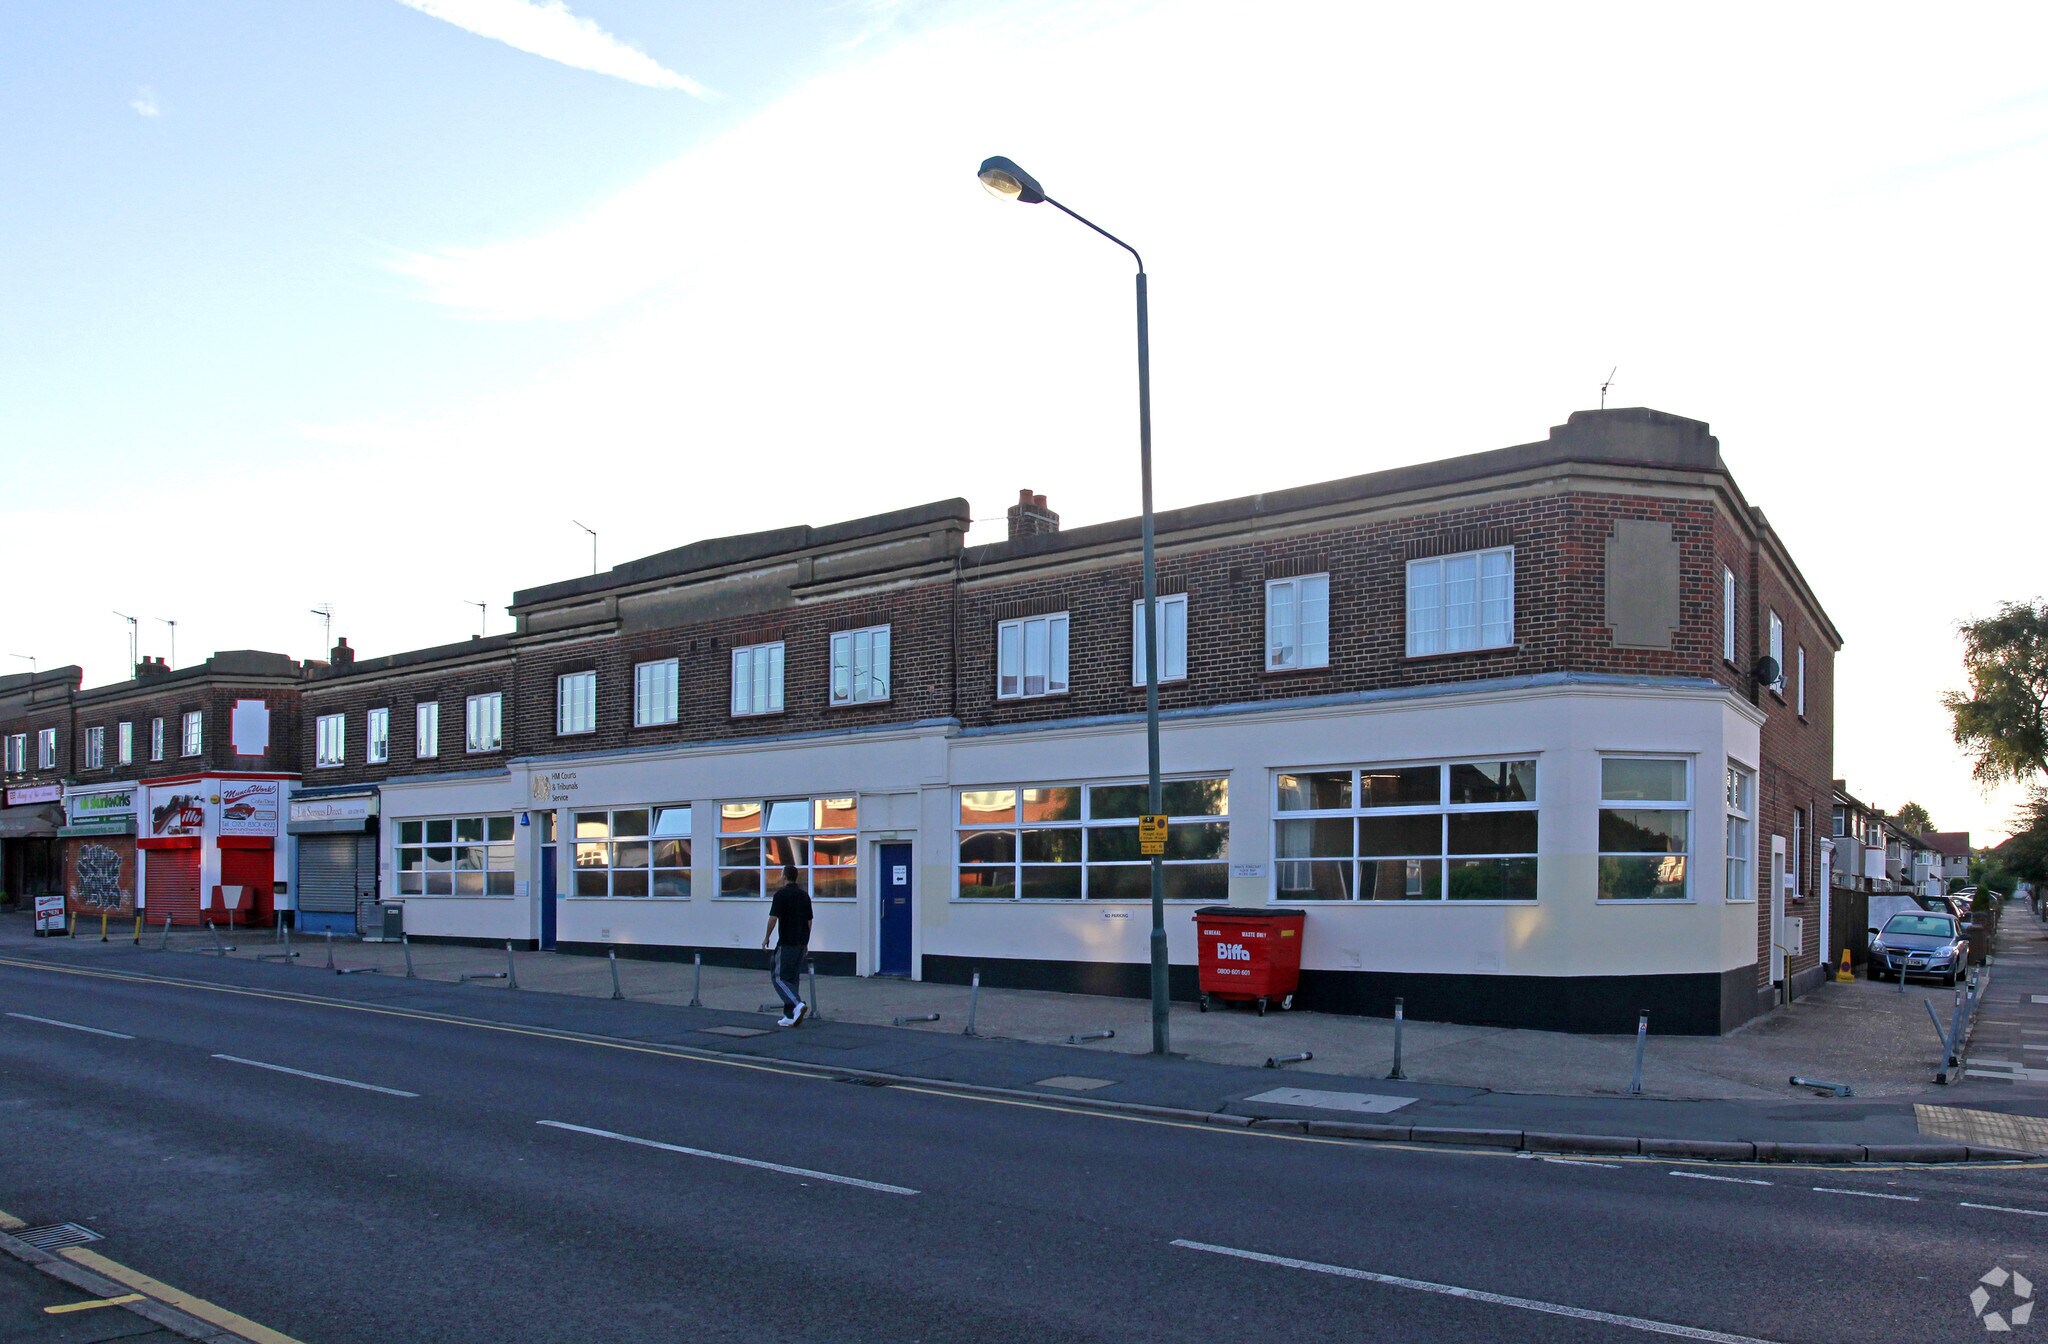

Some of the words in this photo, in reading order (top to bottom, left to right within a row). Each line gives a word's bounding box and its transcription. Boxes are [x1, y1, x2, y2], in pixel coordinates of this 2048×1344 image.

[561, 772, 577, 780] Courts
[557, 782, 578, 790] Tribunals
[182, 809, 202, 825] illy
[1217, 942, 1250, 961] Biffa
